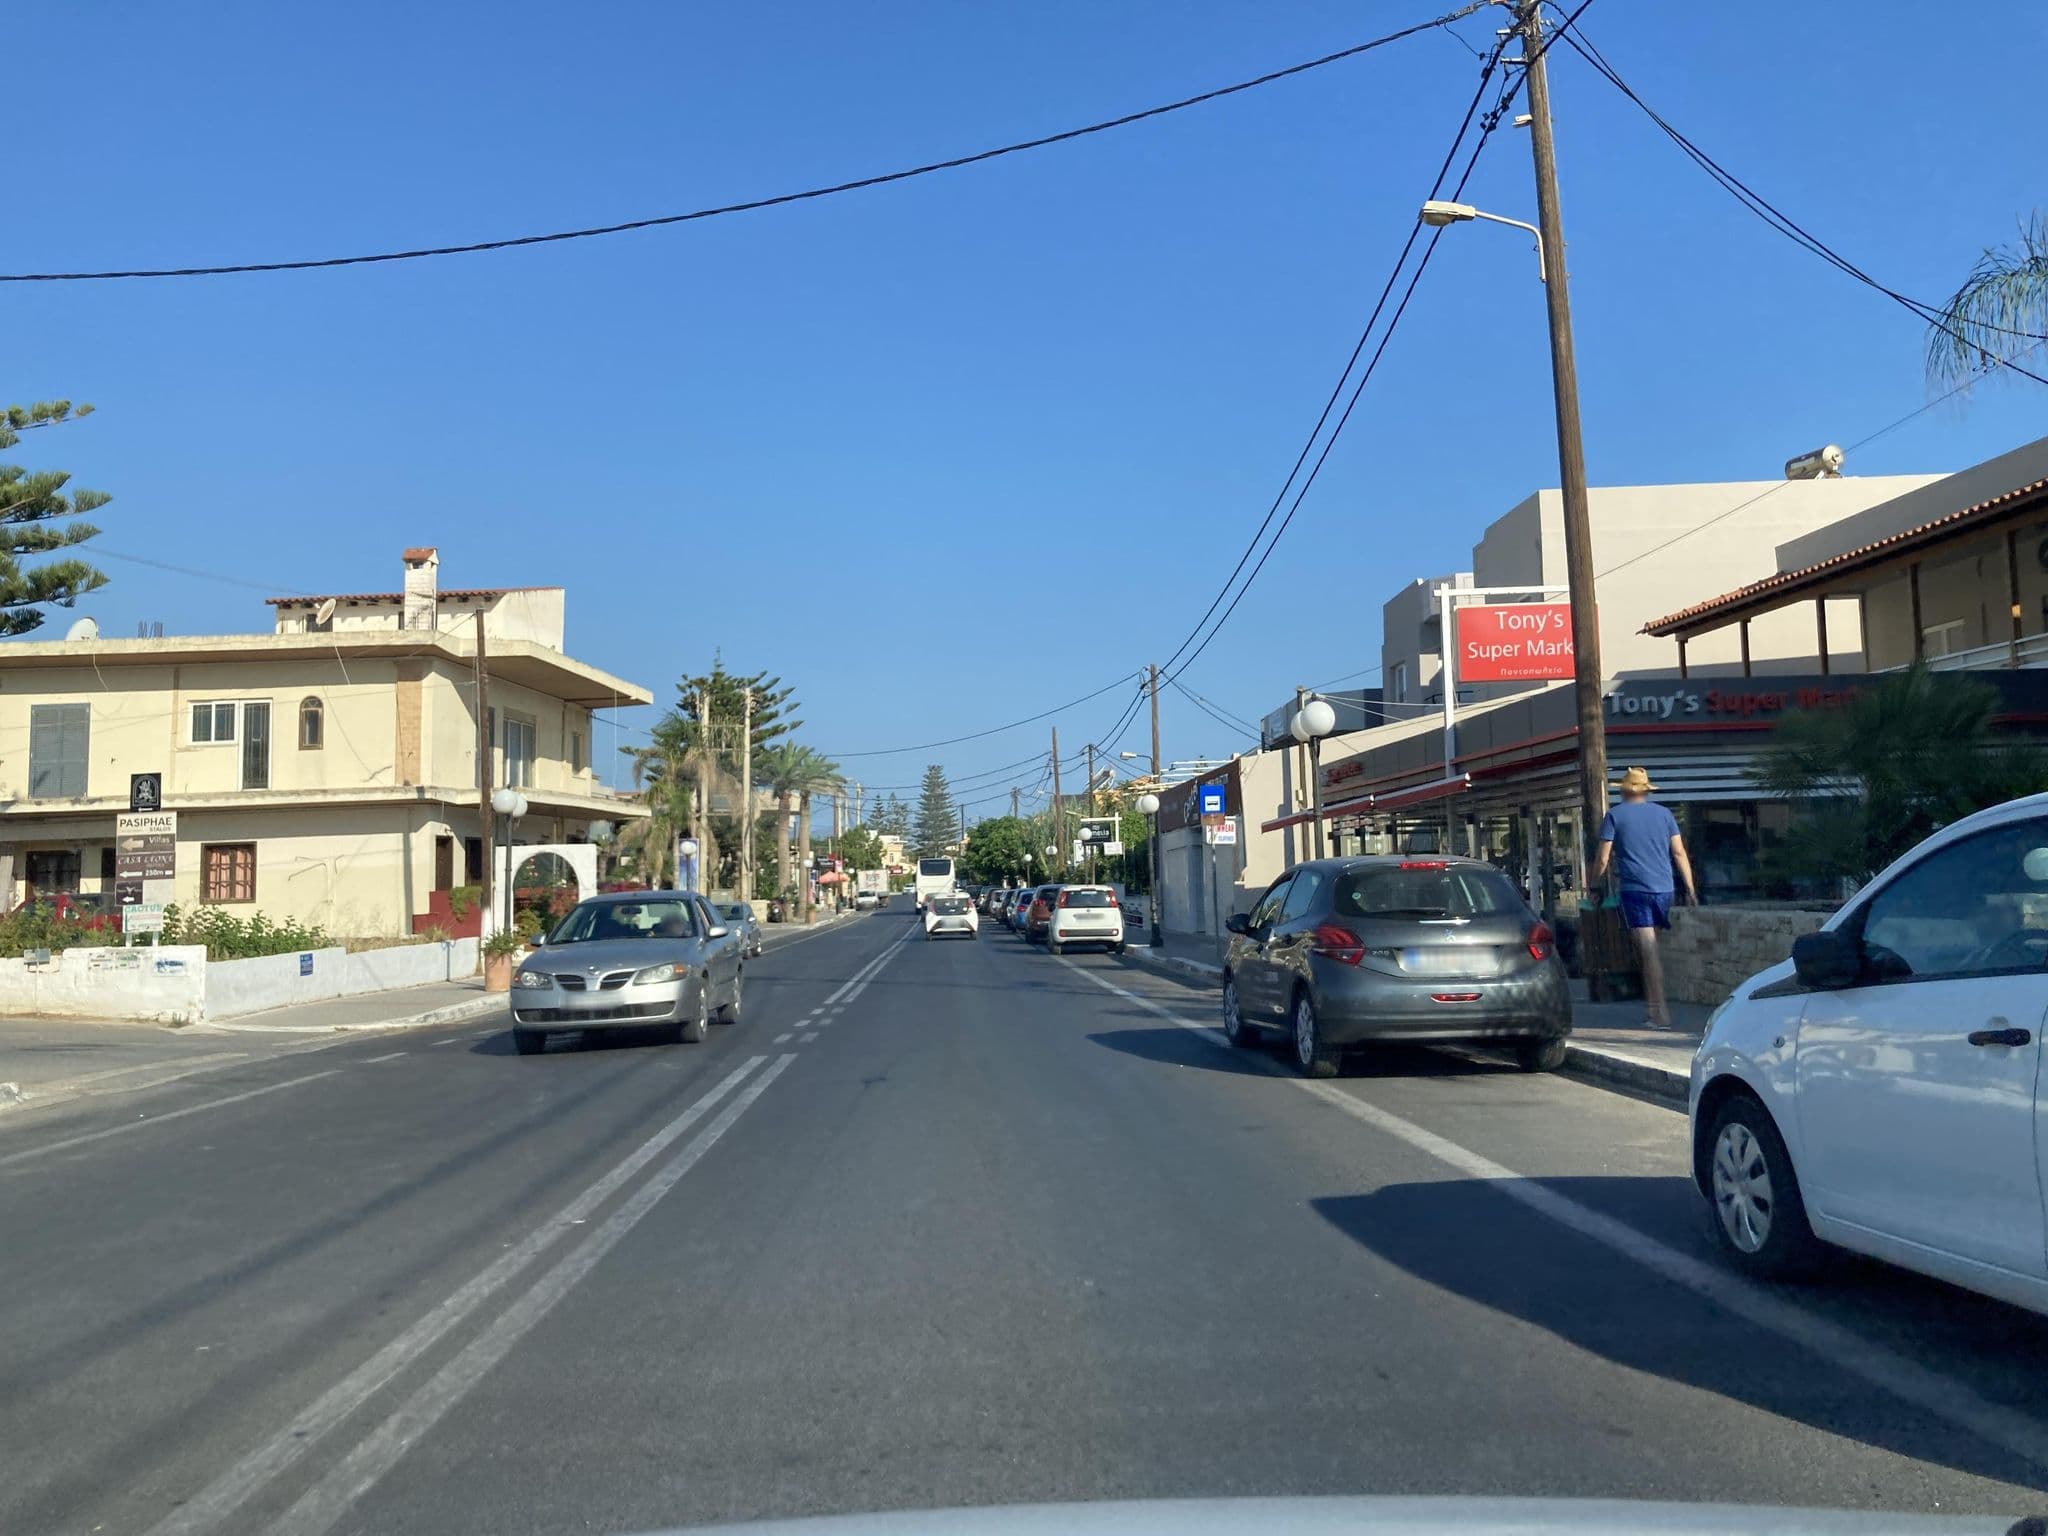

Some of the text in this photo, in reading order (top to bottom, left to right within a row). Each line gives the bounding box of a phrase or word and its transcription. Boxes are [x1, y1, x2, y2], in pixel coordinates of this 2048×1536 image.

[1494, 609, 1565, 633] Tony's
[1467, 638, 1574, 662] Super Mark
[1608, 690, 1699, 719] Tony's
[1706, 686, 1788, 716] Super
[119, 816, 173, 828] PASIPHAE
[148, 836, 171, 844] Villas
[118, 856, 142, 865] CASA
